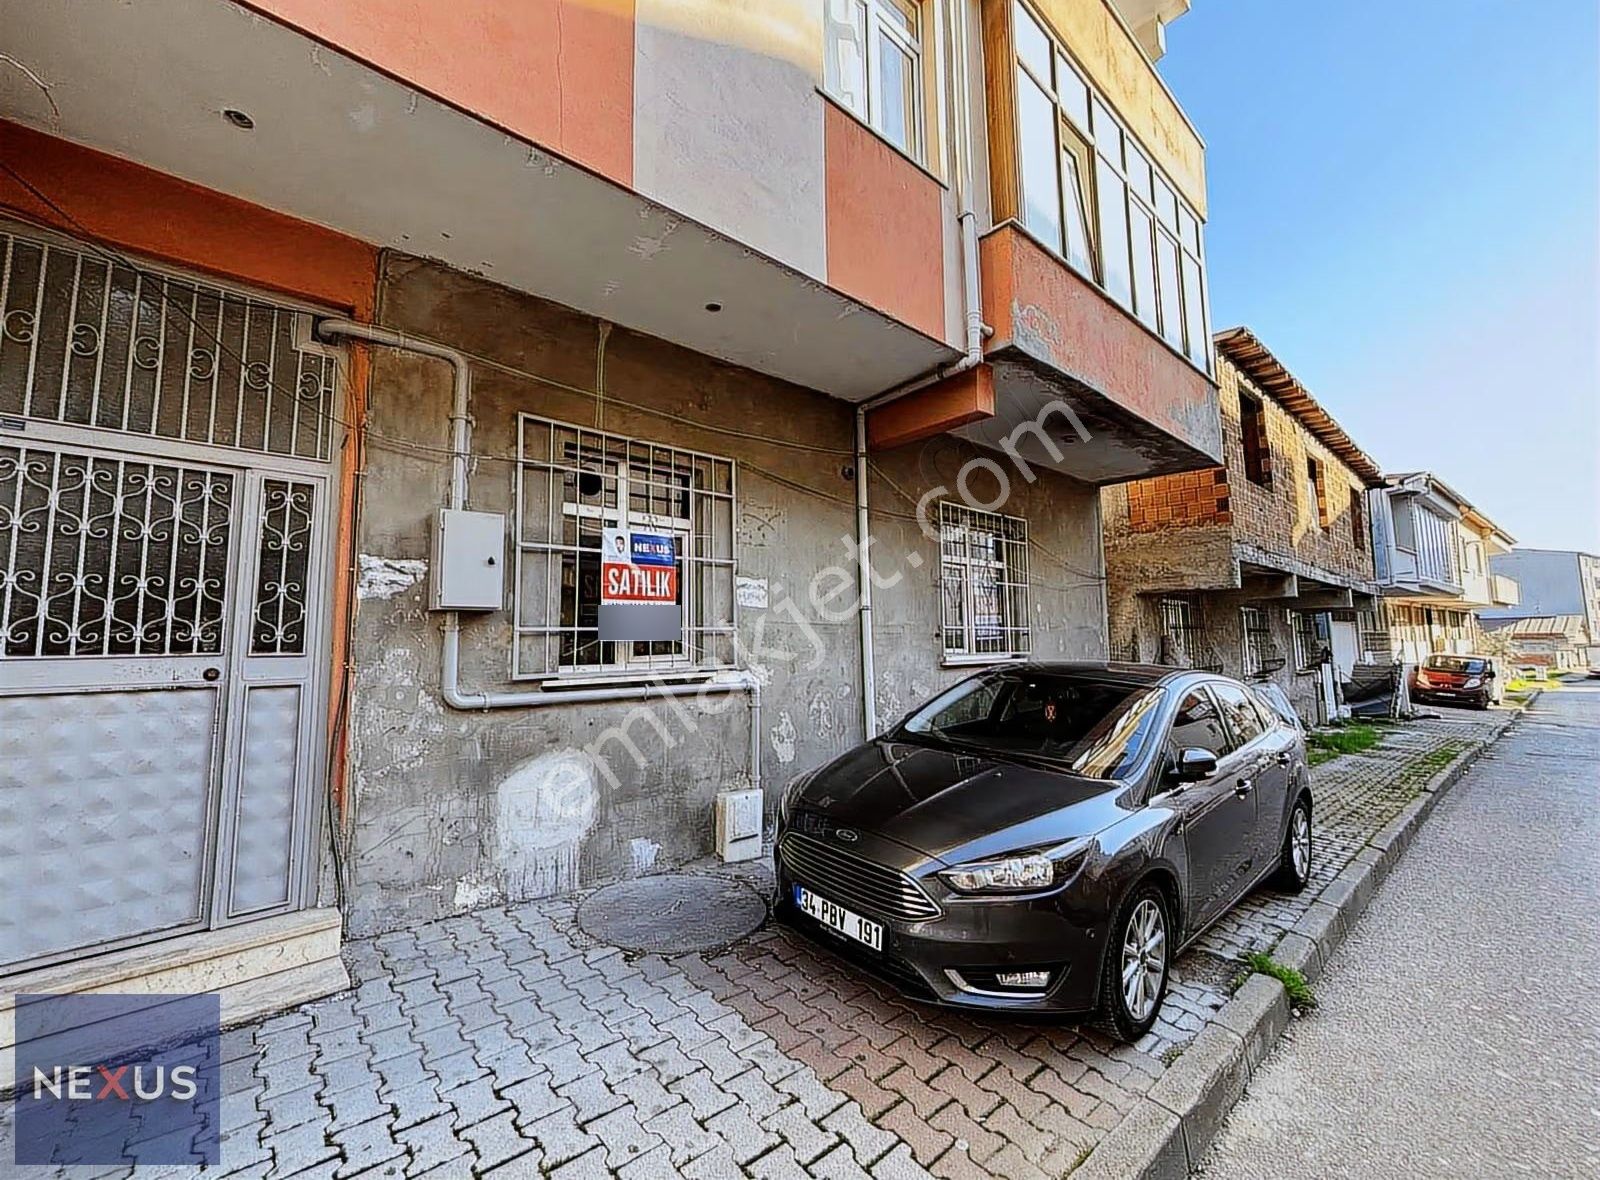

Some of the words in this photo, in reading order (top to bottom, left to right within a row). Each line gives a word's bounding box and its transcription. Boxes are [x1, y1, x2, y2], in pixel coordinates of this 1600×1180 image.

[634, 542, 671, 555] NEXUS
[608, 567, 671, 598] SATILIK
[801, 890, 816, 915] 34
[821, 900, 846, 930] PBV
[857, 918, 881, 949] 191
